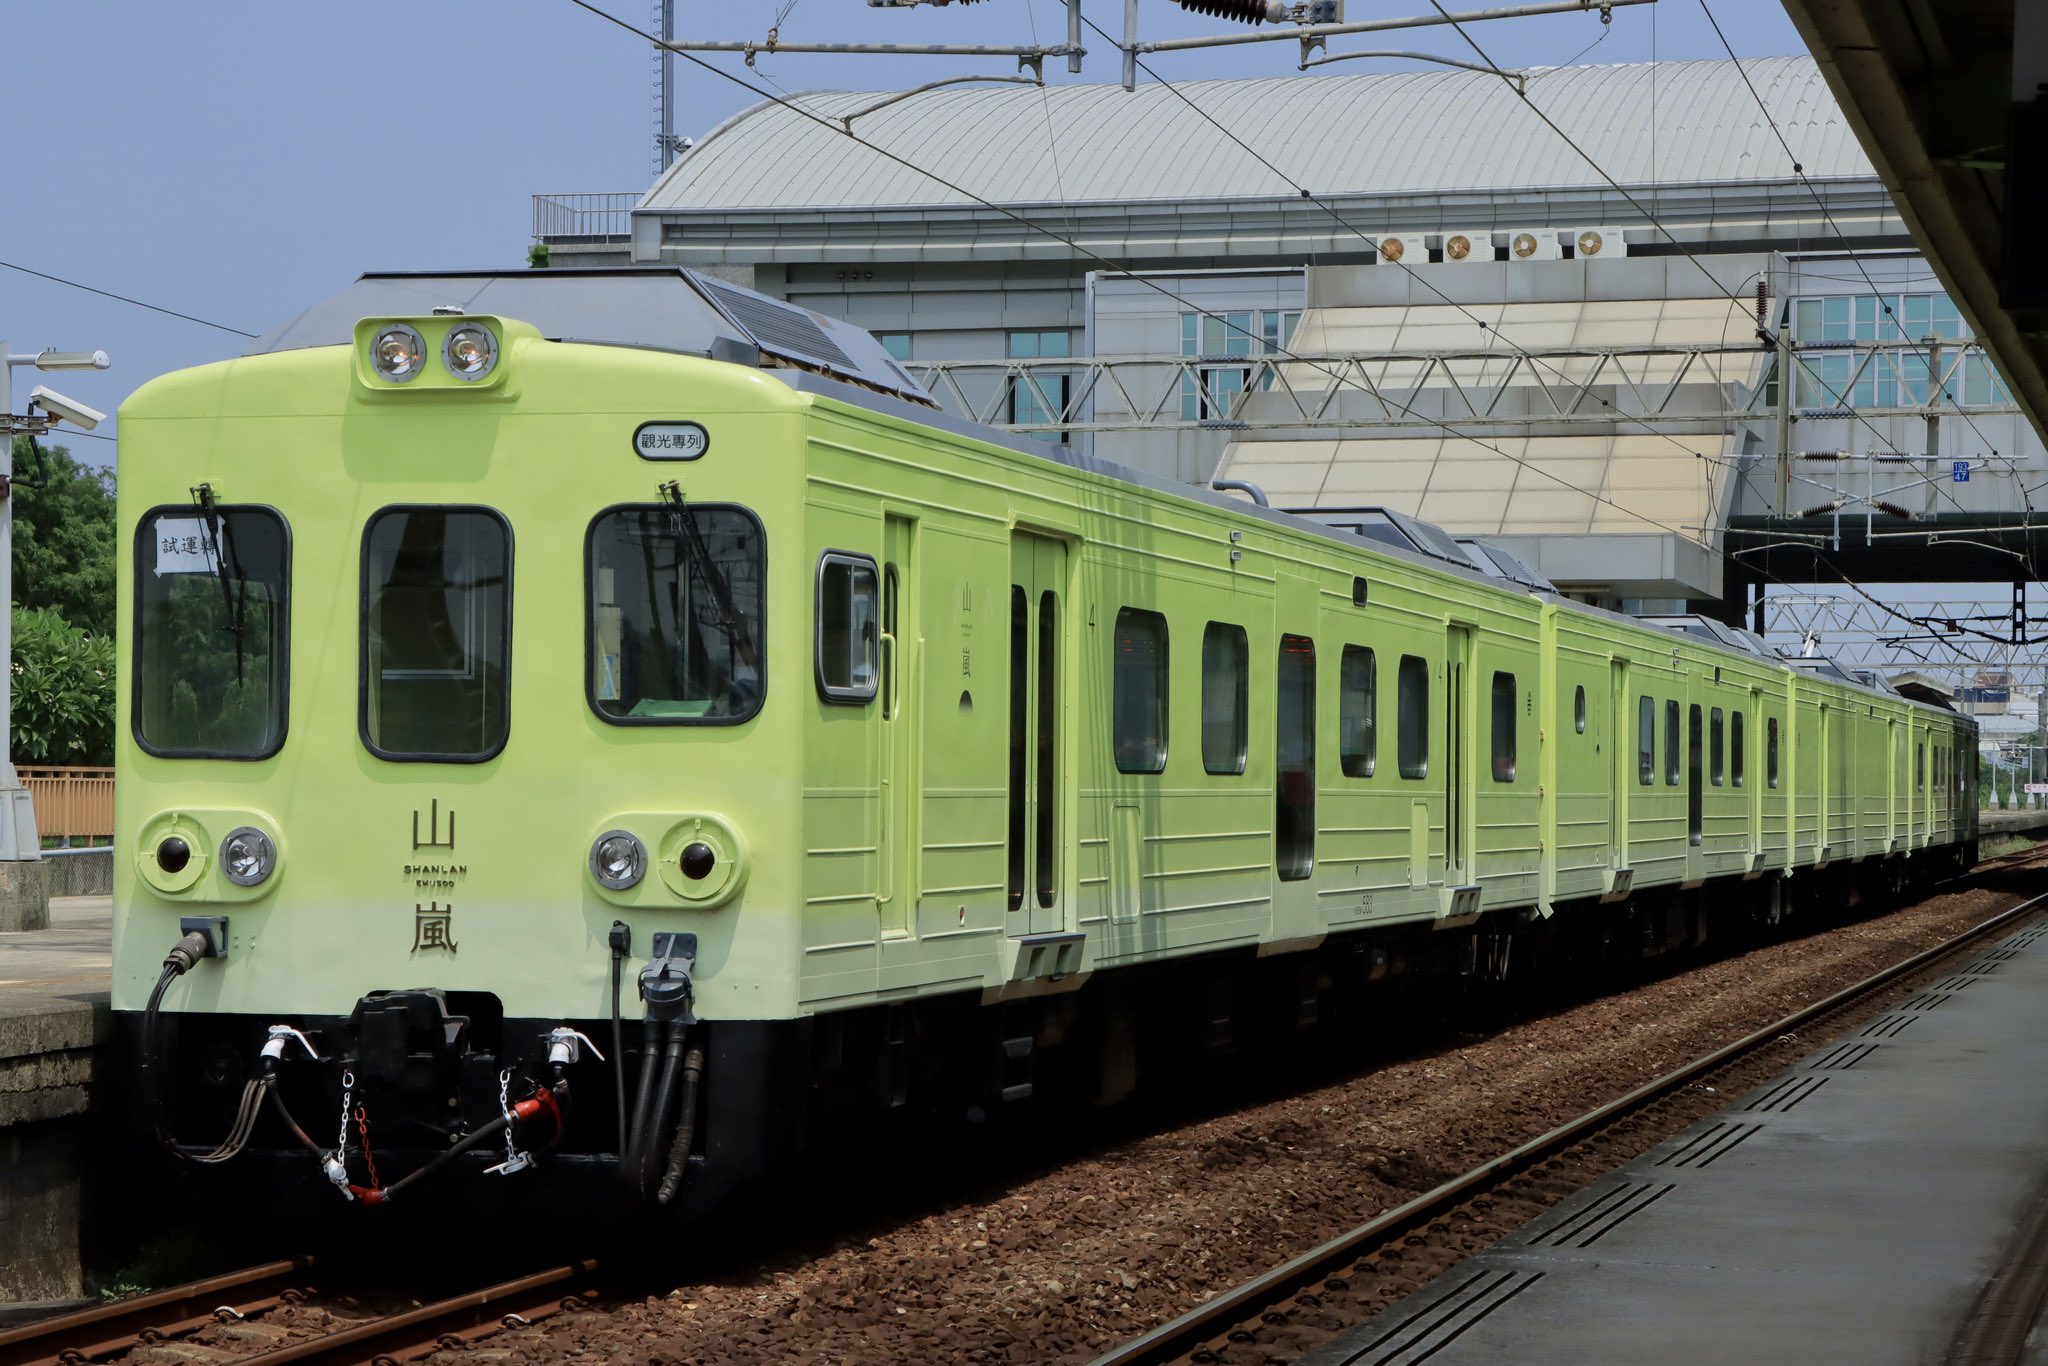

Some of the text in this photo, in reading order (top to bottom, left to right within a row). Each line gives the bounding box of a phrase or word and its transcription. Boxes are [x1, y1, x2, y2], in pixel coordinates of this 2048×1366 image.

[641, 433, 702, 449] 觀光專列
[1954, 462, 1967, 471] 193
[1954, 472, 1967, 481] 47
[413, 798, 455, 850] 山
[403, 865, 467, 874] SHANLAN
[416, 879, 455, 887] EMU500
[410, 901, 459, 953] 嵐
